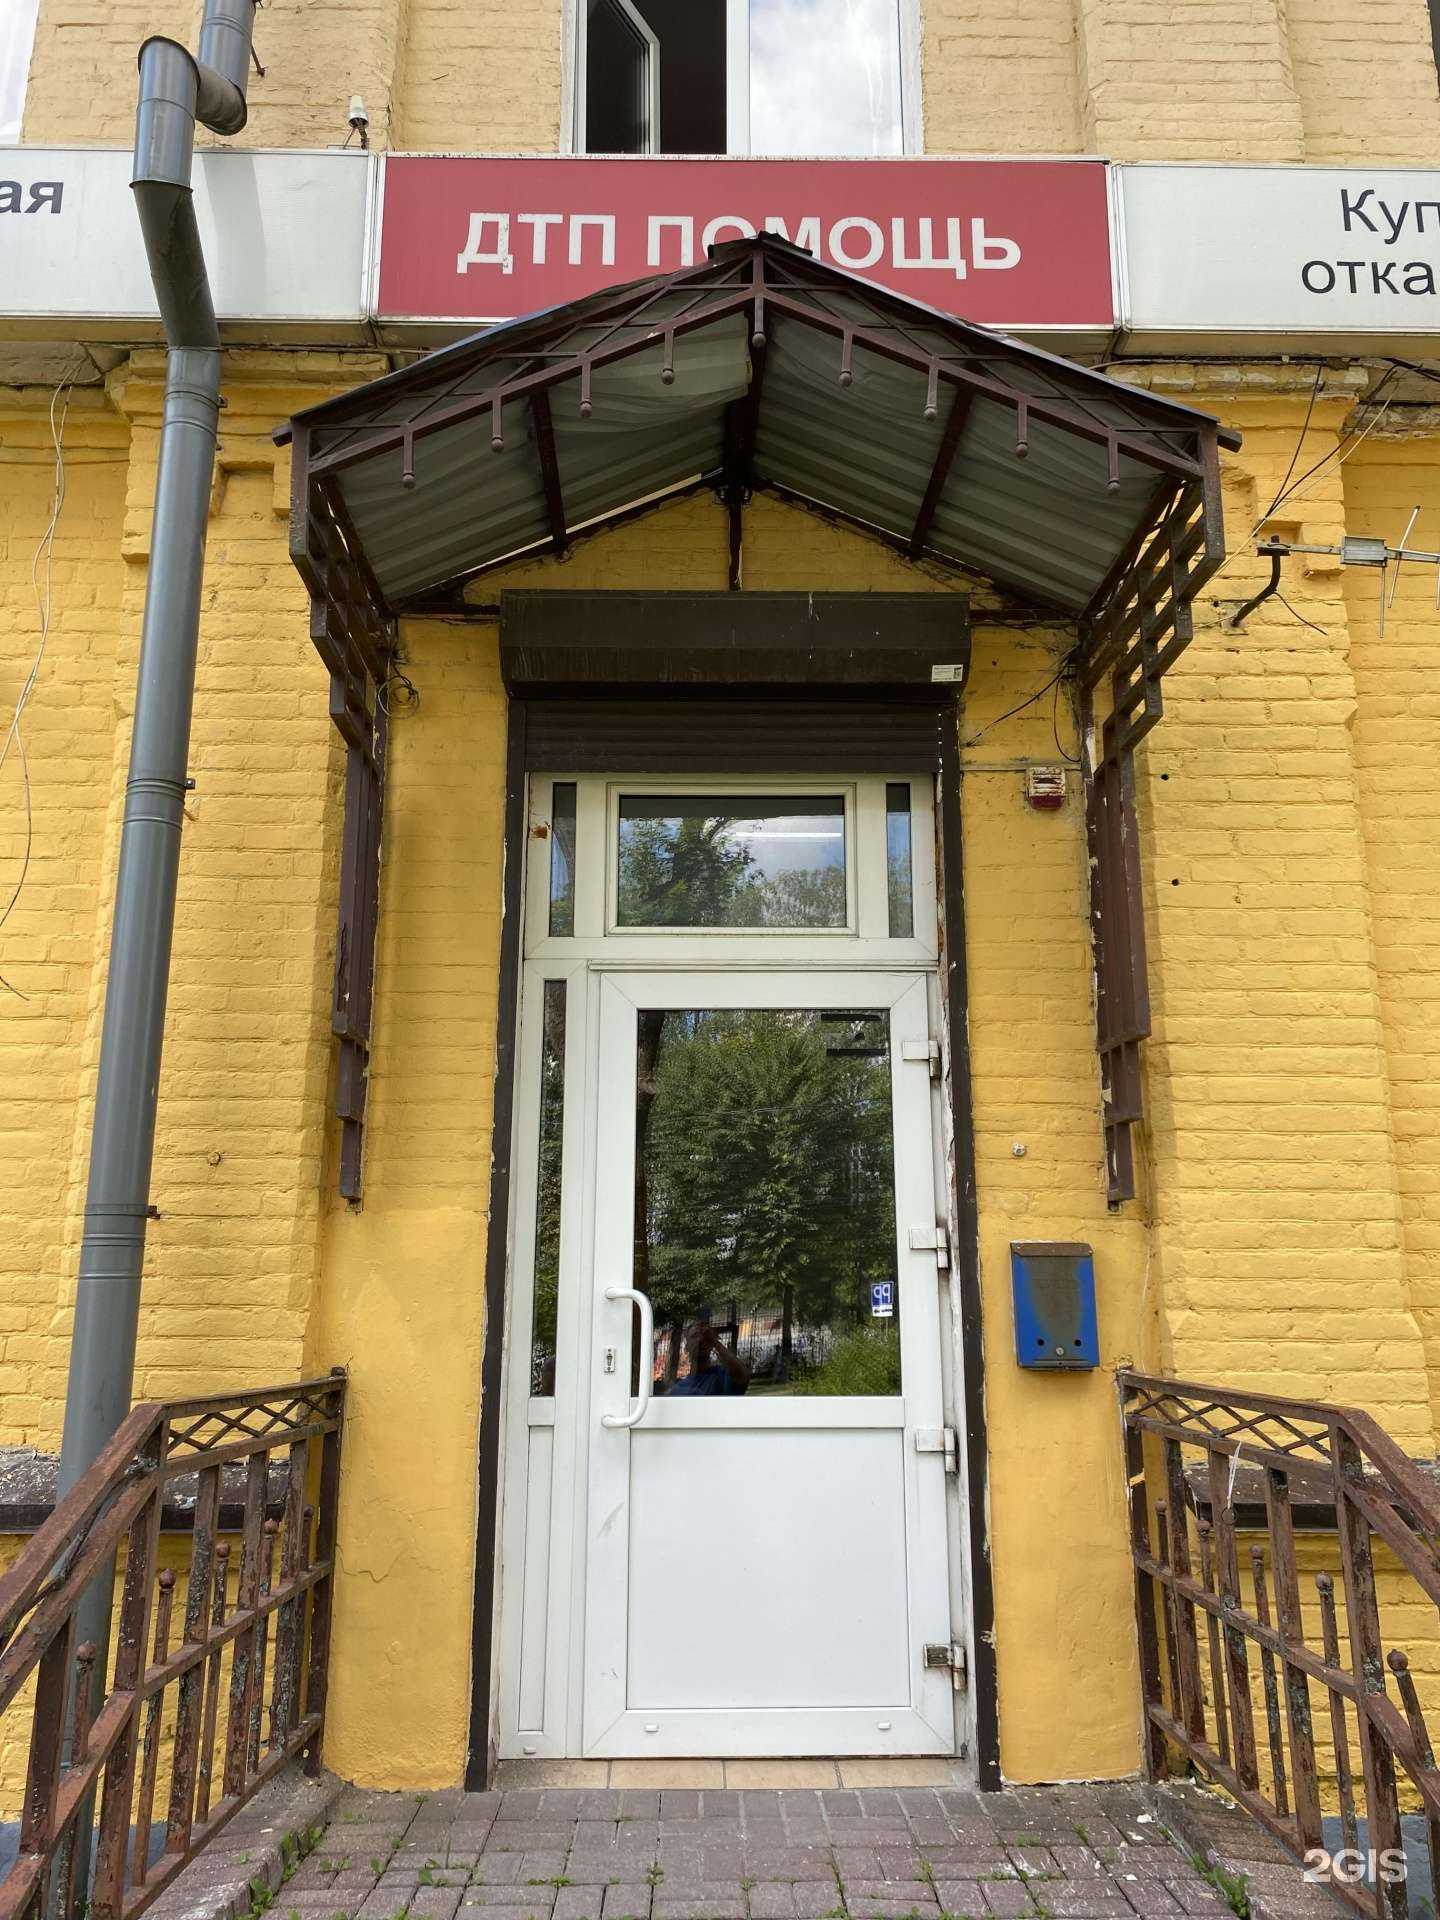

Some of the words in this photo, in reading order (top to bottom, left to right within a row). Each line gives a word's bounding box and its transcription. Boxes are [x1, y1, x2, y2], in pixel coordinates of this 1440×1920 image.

[456, 212, 616, 275] ДТП
[1340, 188, 1440, 245] Куп
[1301, 260, 1437, 295] отка
